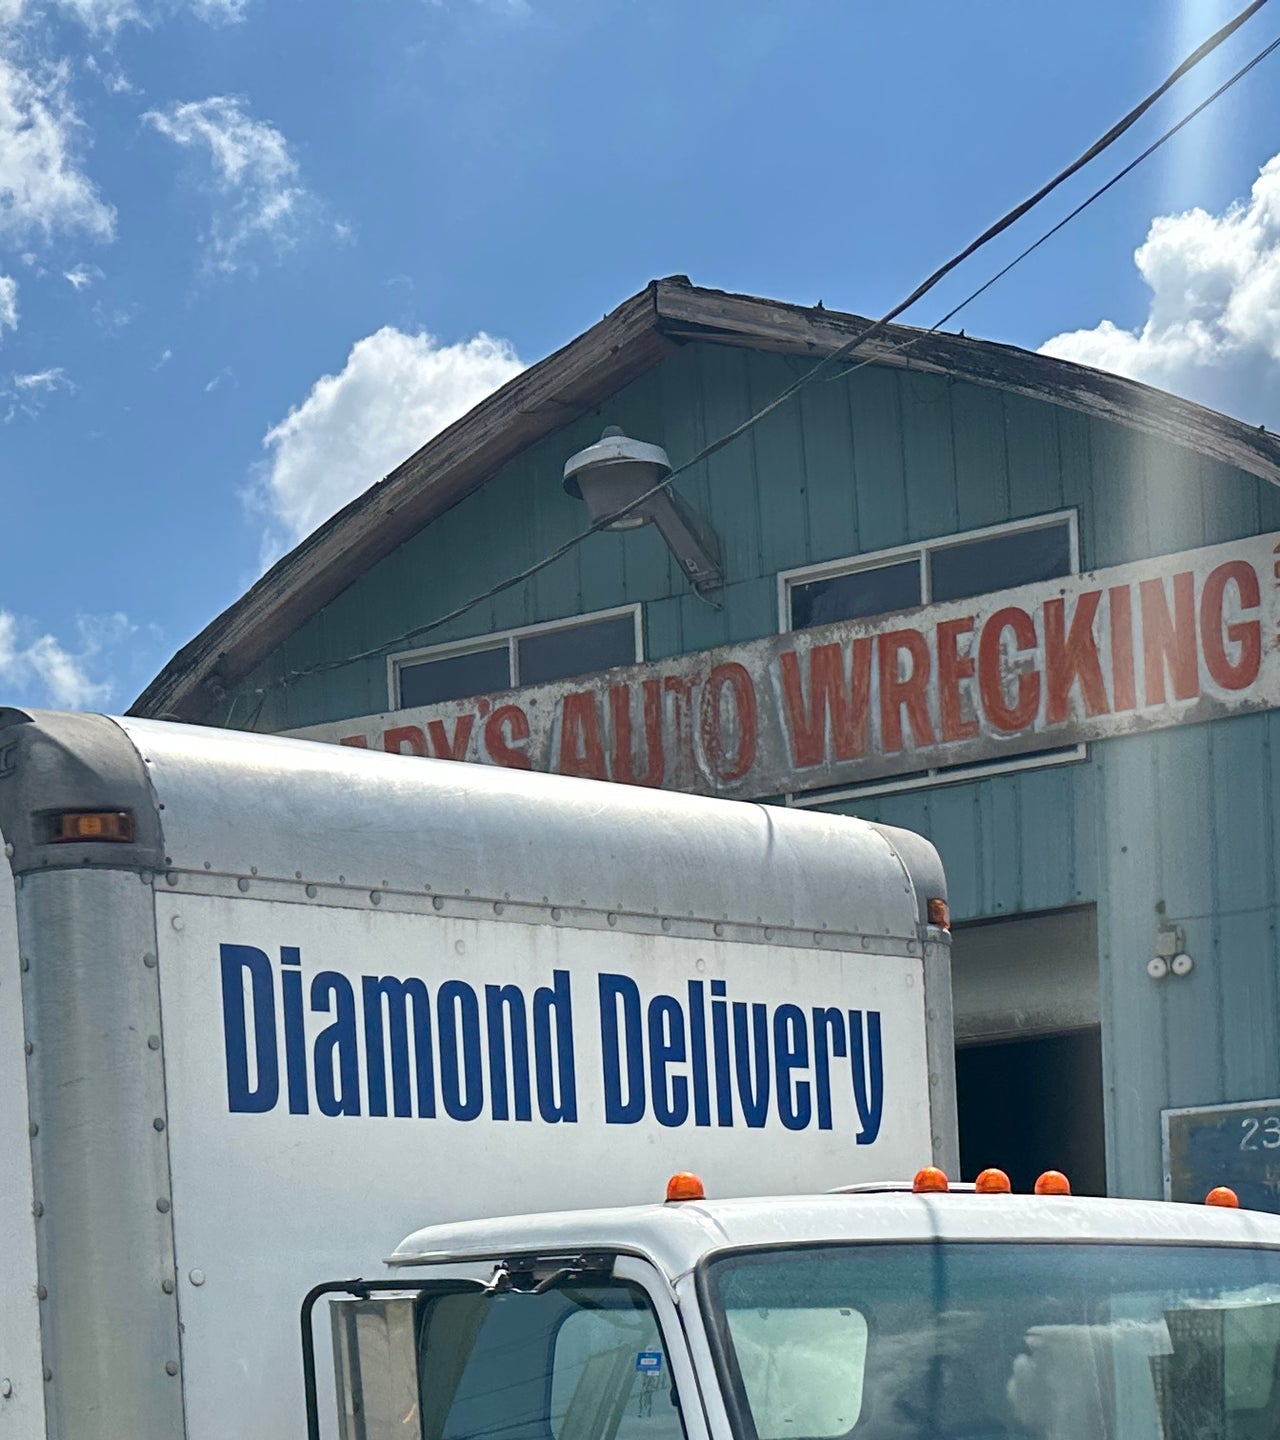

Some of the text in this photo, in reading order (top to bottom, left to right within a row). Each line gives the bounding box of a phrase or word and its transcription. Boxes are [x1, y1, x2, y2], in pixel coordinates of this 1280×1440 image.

[558, 661, 758, 788] AUTO
[781, 559, 1262, 767] WRECKING
[218, 942, 884, 1146] Diamond Delivery
